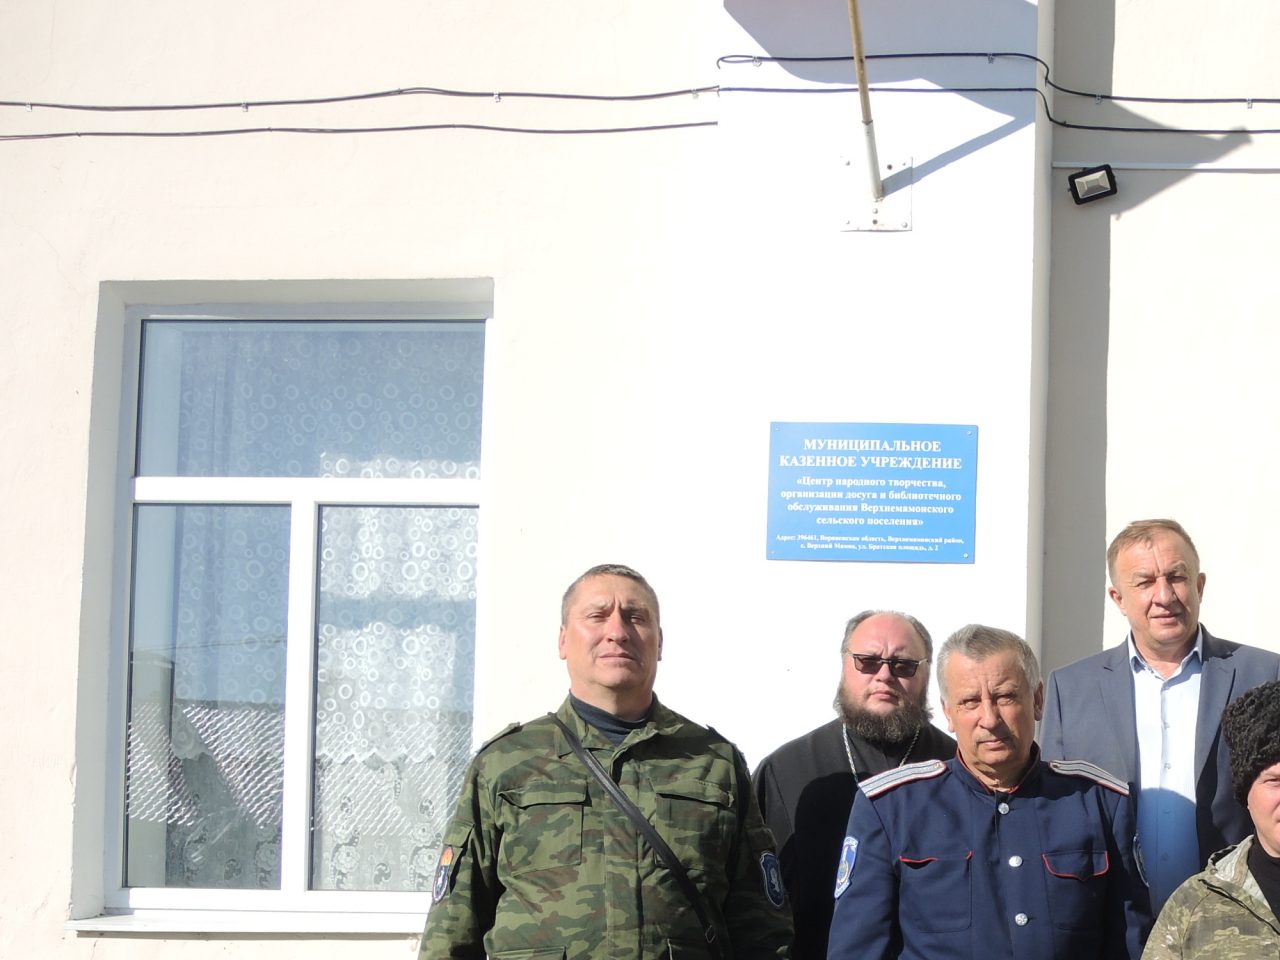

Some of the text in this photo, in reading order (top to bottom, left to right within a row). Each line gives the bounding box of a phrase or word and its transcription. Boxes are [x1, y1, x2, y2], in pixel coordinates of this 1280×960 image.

[803, 438, 942, 452] МУНИЦИПАЛЬНОЕ
[779, 455, 963, 470] КАЗЕННОЕ УЧРЕЖДЕНИЕ
[797, 476, 947, 489] «Центр народного творчества,
[780, 490, 844, 500] организации
[844, 491, 878, 501] досуга
[888, 490, 962, 501] библиотечного
[787, 502, 954, 514] обслуживания Верхнемамонского
[816, 517, 924, 527] сельского поселения»
